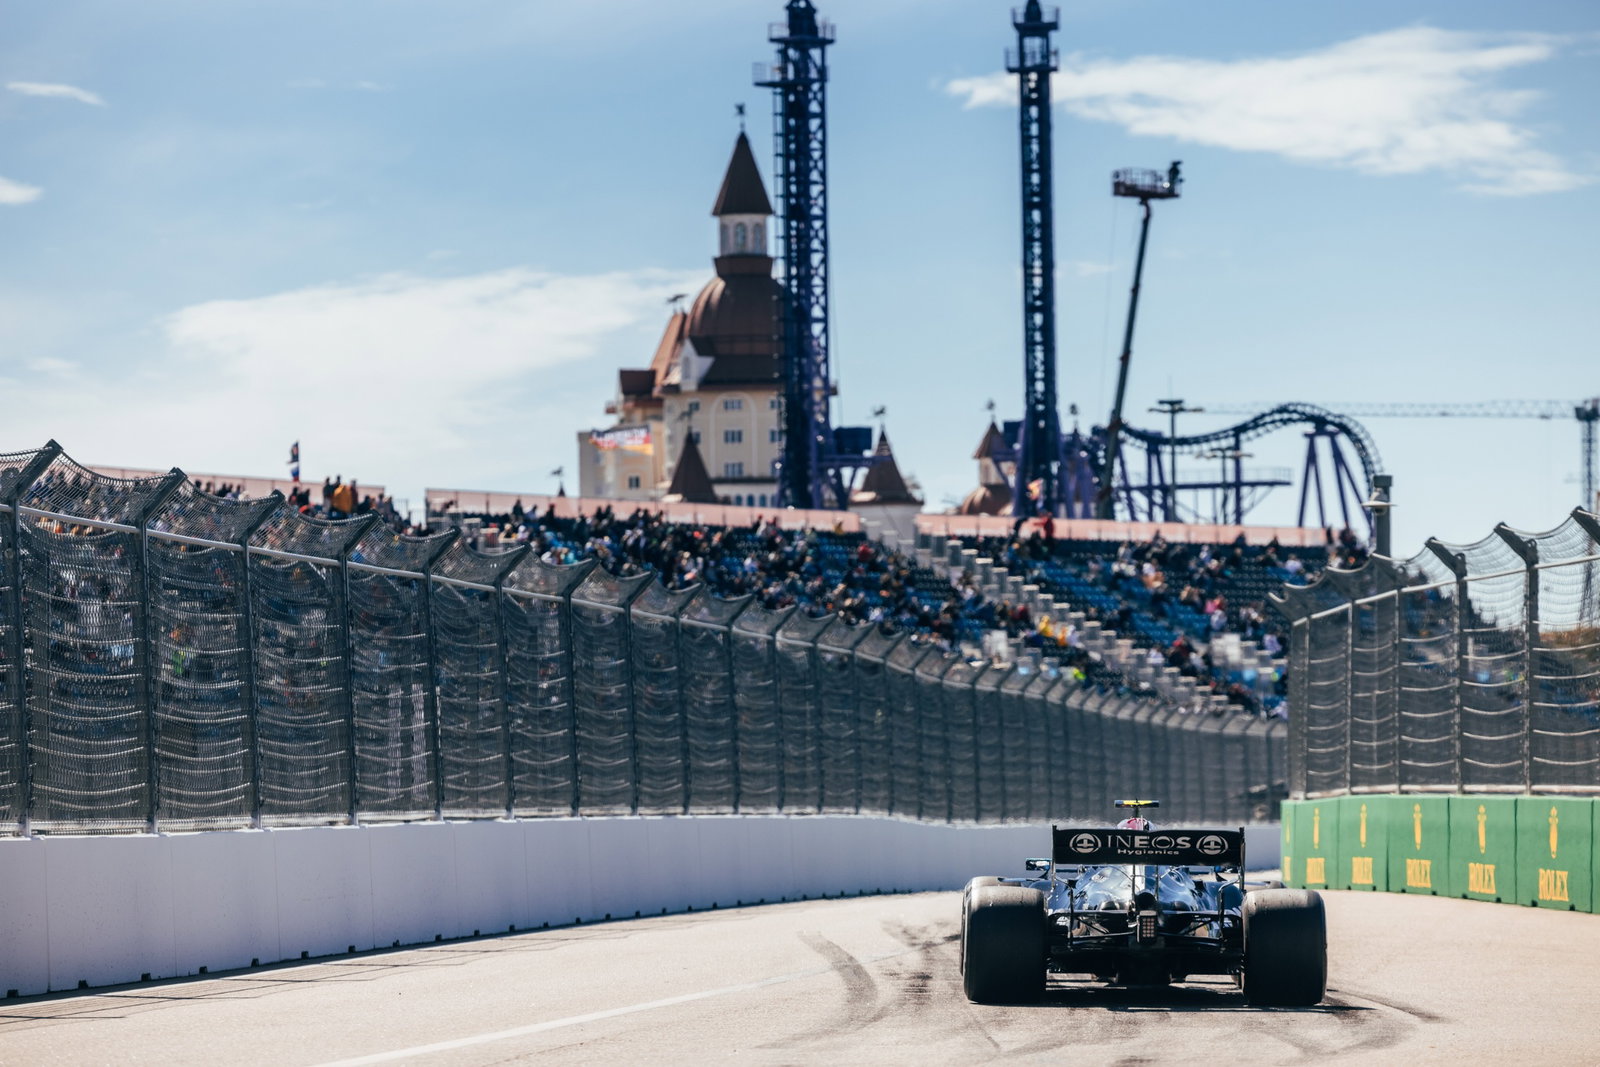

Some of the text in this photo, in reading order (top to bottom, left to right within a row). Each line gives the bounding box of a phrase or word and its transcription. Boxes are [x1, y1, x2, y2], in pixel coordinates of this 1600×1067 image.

[1108, 835, 1191, 849] INEOS
[1468, 862, 1497, 895] ROLEX
[1538, 868, 1570, 902] ROLEX
